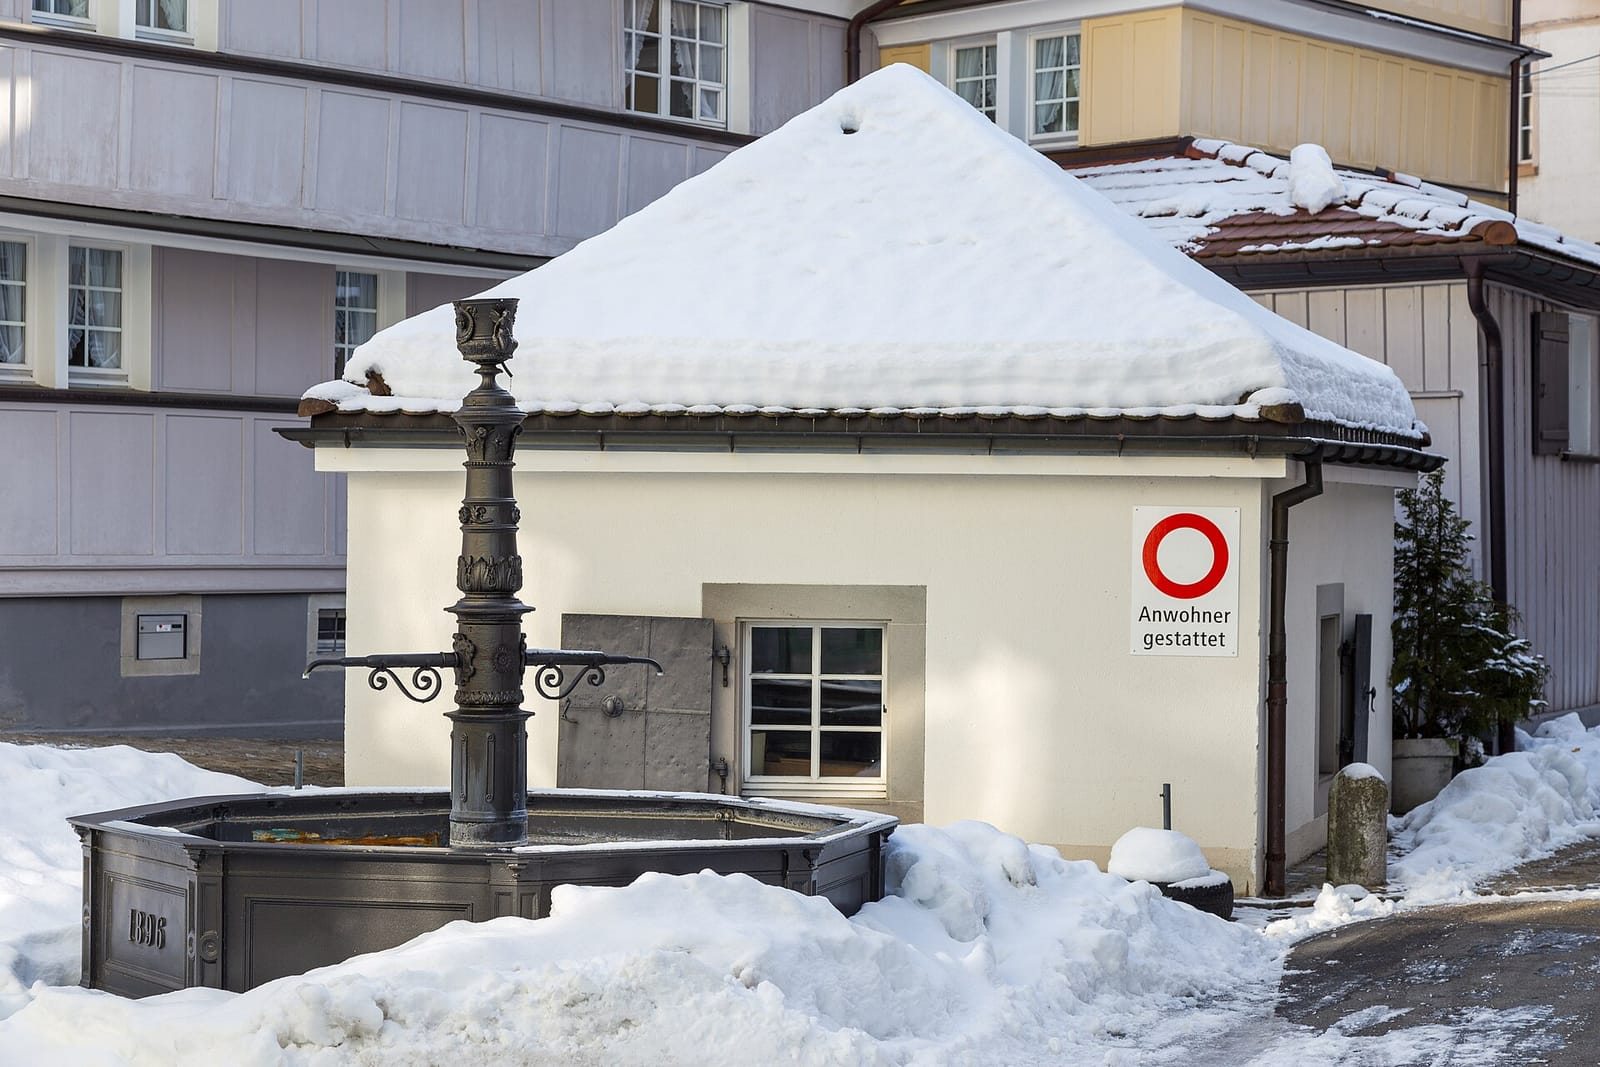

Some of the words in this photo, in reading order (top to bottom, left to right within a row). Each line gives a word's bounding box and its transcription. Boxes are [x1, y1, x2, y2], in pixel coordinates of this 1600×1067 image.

[1138, 606, 1231, 623] Anwohner
[1143, 631, 1226, 650] gestattet
[128, 908, 167, 949] 1896
